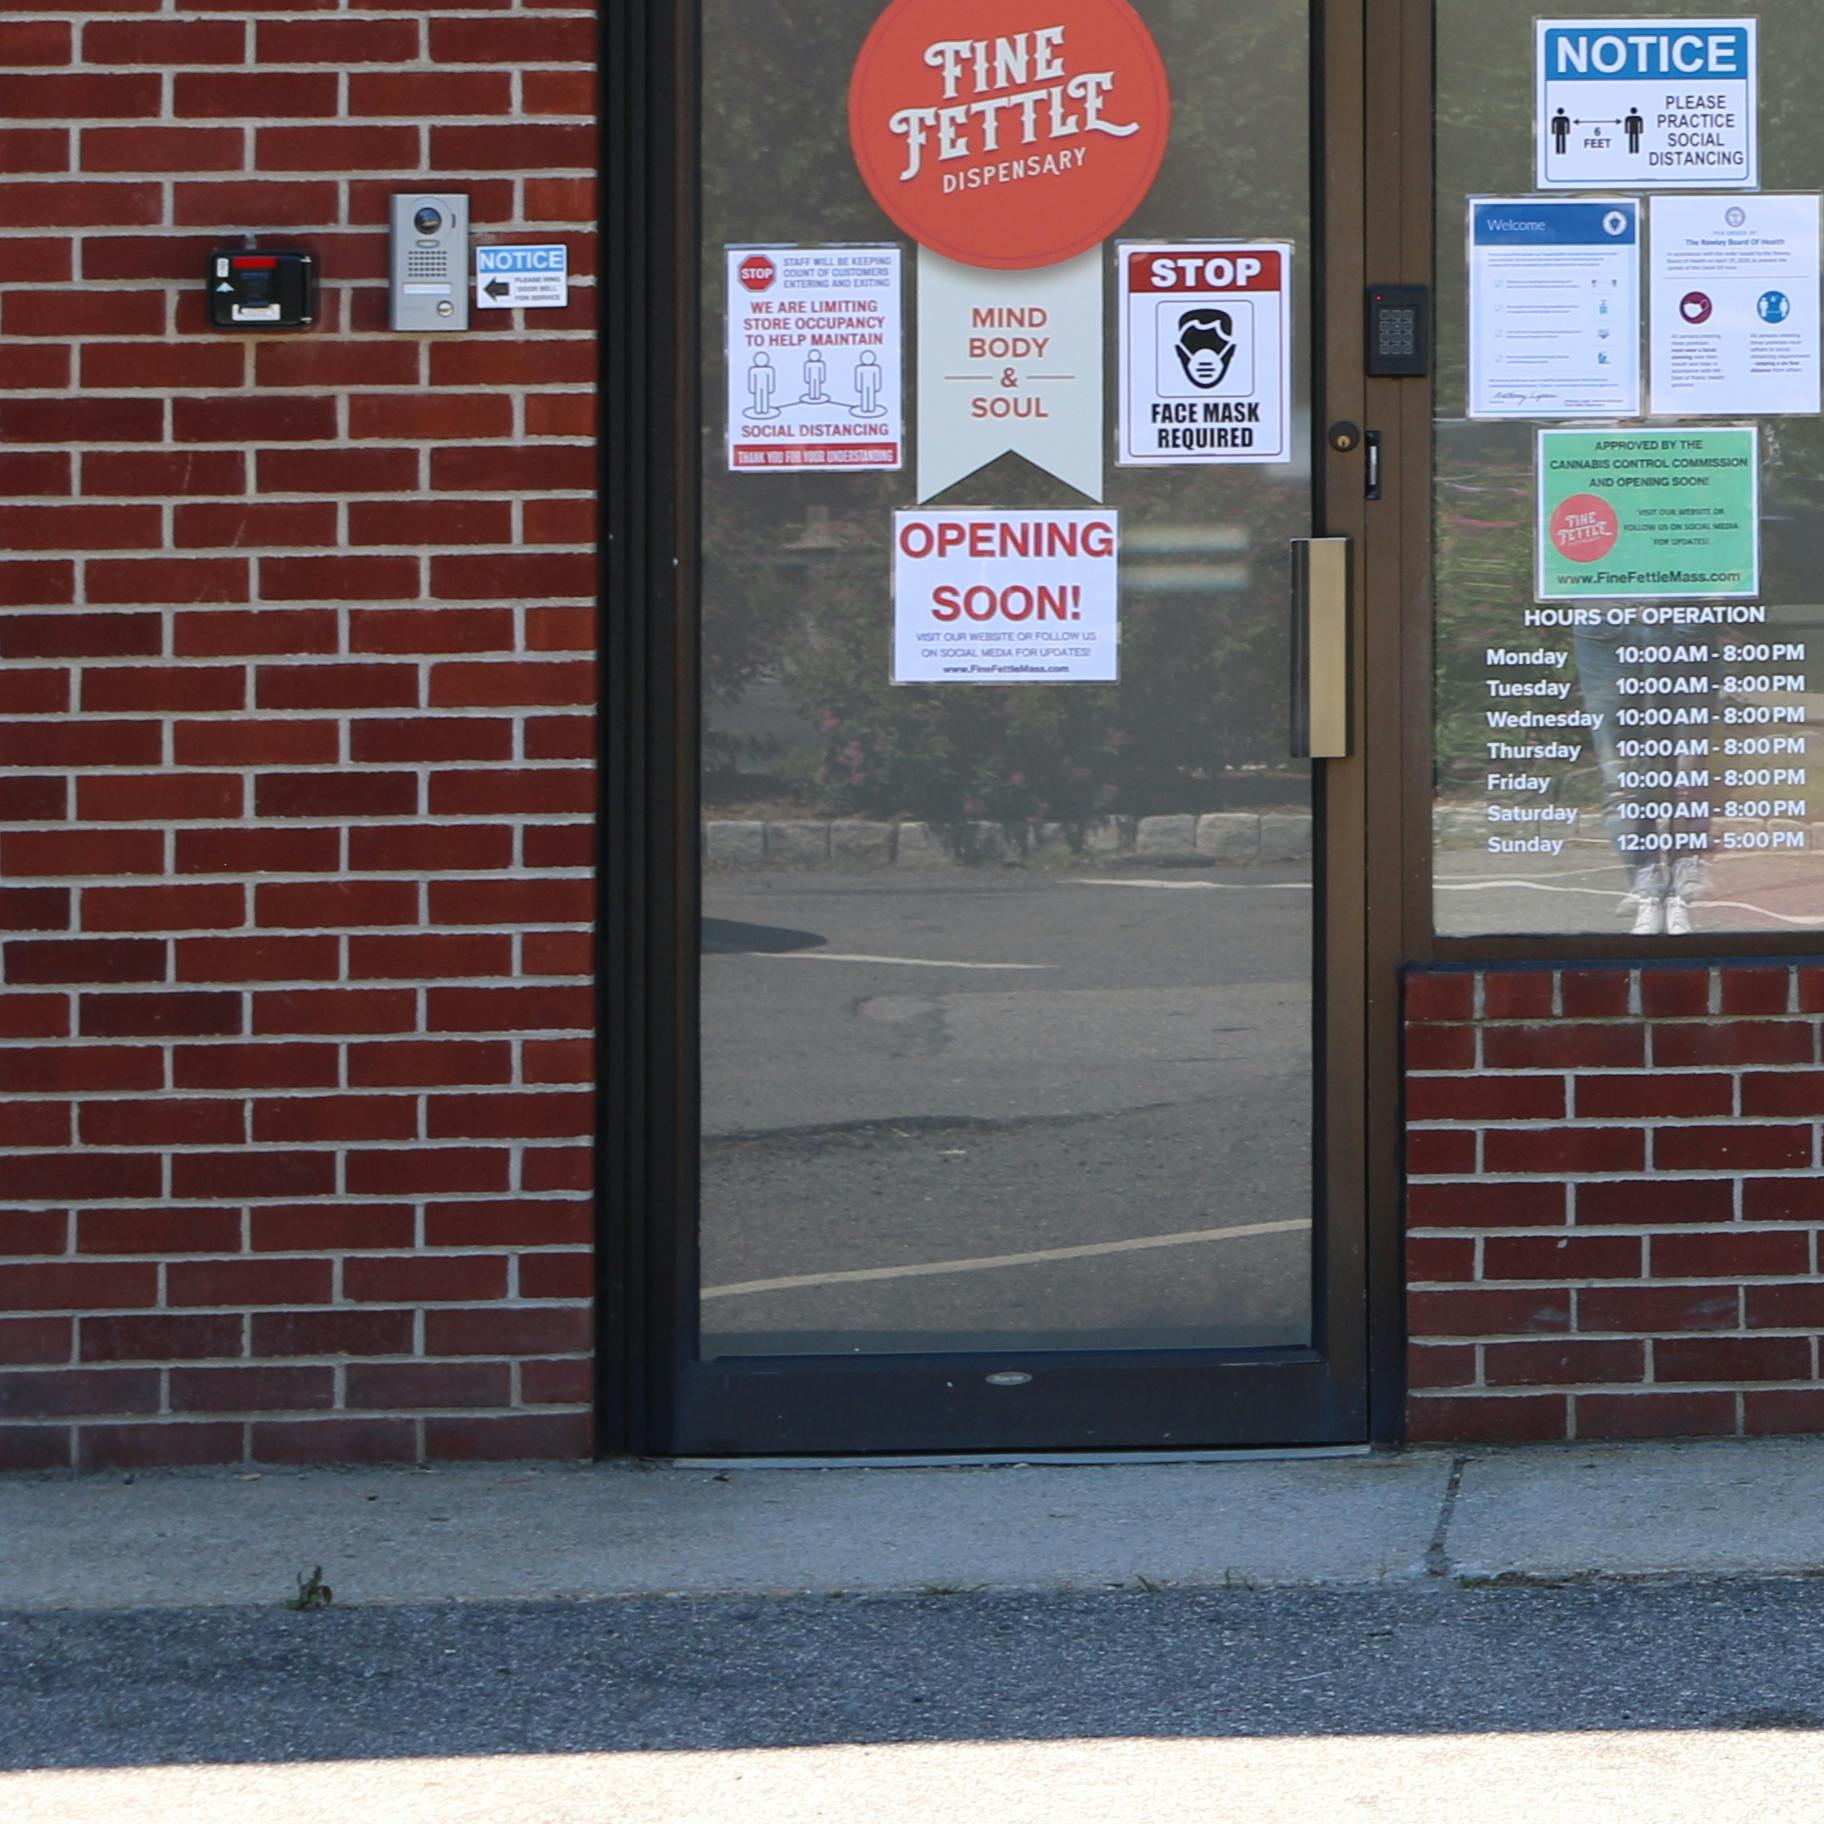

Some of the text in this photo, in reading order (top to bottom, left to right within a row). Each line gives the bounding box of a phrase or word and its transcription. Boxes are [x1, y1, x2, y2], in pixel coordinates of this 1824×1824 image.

[924, 26, 1066, 99] FINE
[1558, 36, 1736, 72] NOTICE
[1666, 95, 1726, 109] PLEASE
[889, 71, 1139, 181] FETTLE
[1658, 114, 1734, 128] PRACTICE
[1593, 127, 1602, 137] 6
[1668, 133, 1724, 147] SOCIAL
[1583, 139, 1612, 149] FEET
[1650, 151, 1743, 165] DISTANCING
[942, 147, 1086, 193] DISPENSARY
[1487, 220, 1545, 230] Welcome
[480, 251, 563, 269] NOTICE
[741, 268, 772, 280] STOP
[1152, 258, 1260, 287] STOP
[783, 279, 890, 289] ENTERING AND EXITING
[751, 300, 877, 313] WE ARE LIMITING
[744, 317, 884, 330] STORE OCCUPANCY
[973, 308, 1046, 327] MIND
[746, 333, 882, 346] TO HELP MAINTAIN
[970, 338, 1049, 358] BODY
[1001, 368, 1017, 387] &
[972, 397, 1048, 418] SOUL
[1152, 403, 1259, 423] FACE MASK
[742, 424, 888, 437] SOCIAL DISTANCING
[1159, 428, 1252, 450] REQUIRED
[1594, 440, 1703, 451] APPROVED BY THE
[1549, 458, 1748, 470] CANNABIS CONTROL COMMISSION
[1589, 477, 1709, 488] AND OPENING SOON!
[1566, 512, 1597, 527] FINE
[900, 522, 1112, 558] OPENING
[1557, 521, 1613, 546] FETTLE
[932, 585, 1080, 621] SOON!
[1525, 606, 1764, 625] HOURS OF OPERATION
[915, 632, 1097, 642] VISIT OUR WEBSITE OR FOLLOW US
[921, 648, 1091, 658] ON SOCIAL MEDIA FOR UPDATES!
[1487, 649, 1567, 668] Monday
[1486, 680, 1570, 699] Tuesday
[1487, 710, 1604, 730] Wednesday
[1487, 742, 1581, 762] Thursday
[1488, 774, 1550, 793] Friday
[1488, 805, 1578, 824] Saturday
[1488, 836, 1564, 855] Sunday
